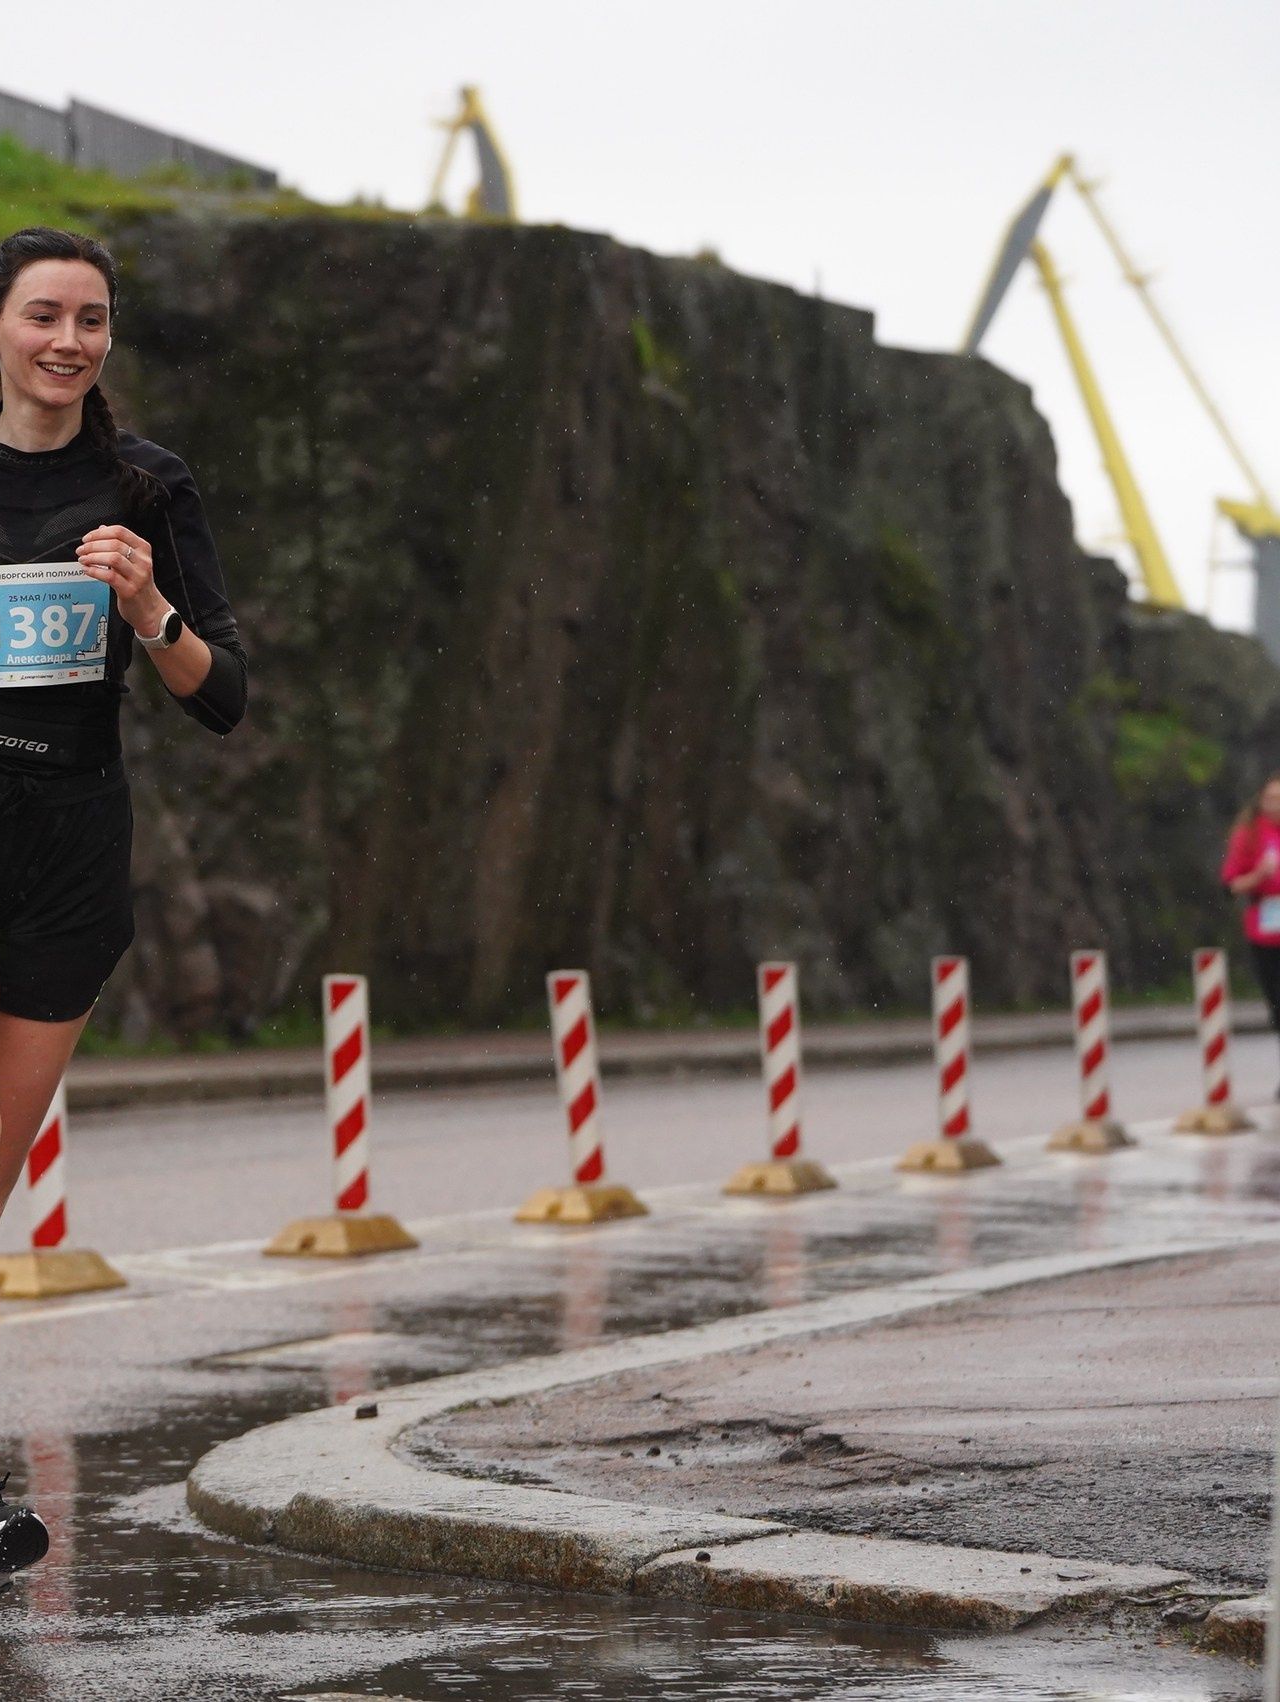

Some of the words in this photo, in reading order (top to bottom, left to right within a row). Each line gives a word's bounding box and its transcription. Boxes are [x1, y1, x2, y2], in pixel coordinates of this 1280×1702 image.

[45, 569, 87, 578] ПОЛУМАР
[20, 594, 41, 602] МАЯ
[48, 593, 57, 601] 10
[6, 653, 72, 665] Александра
